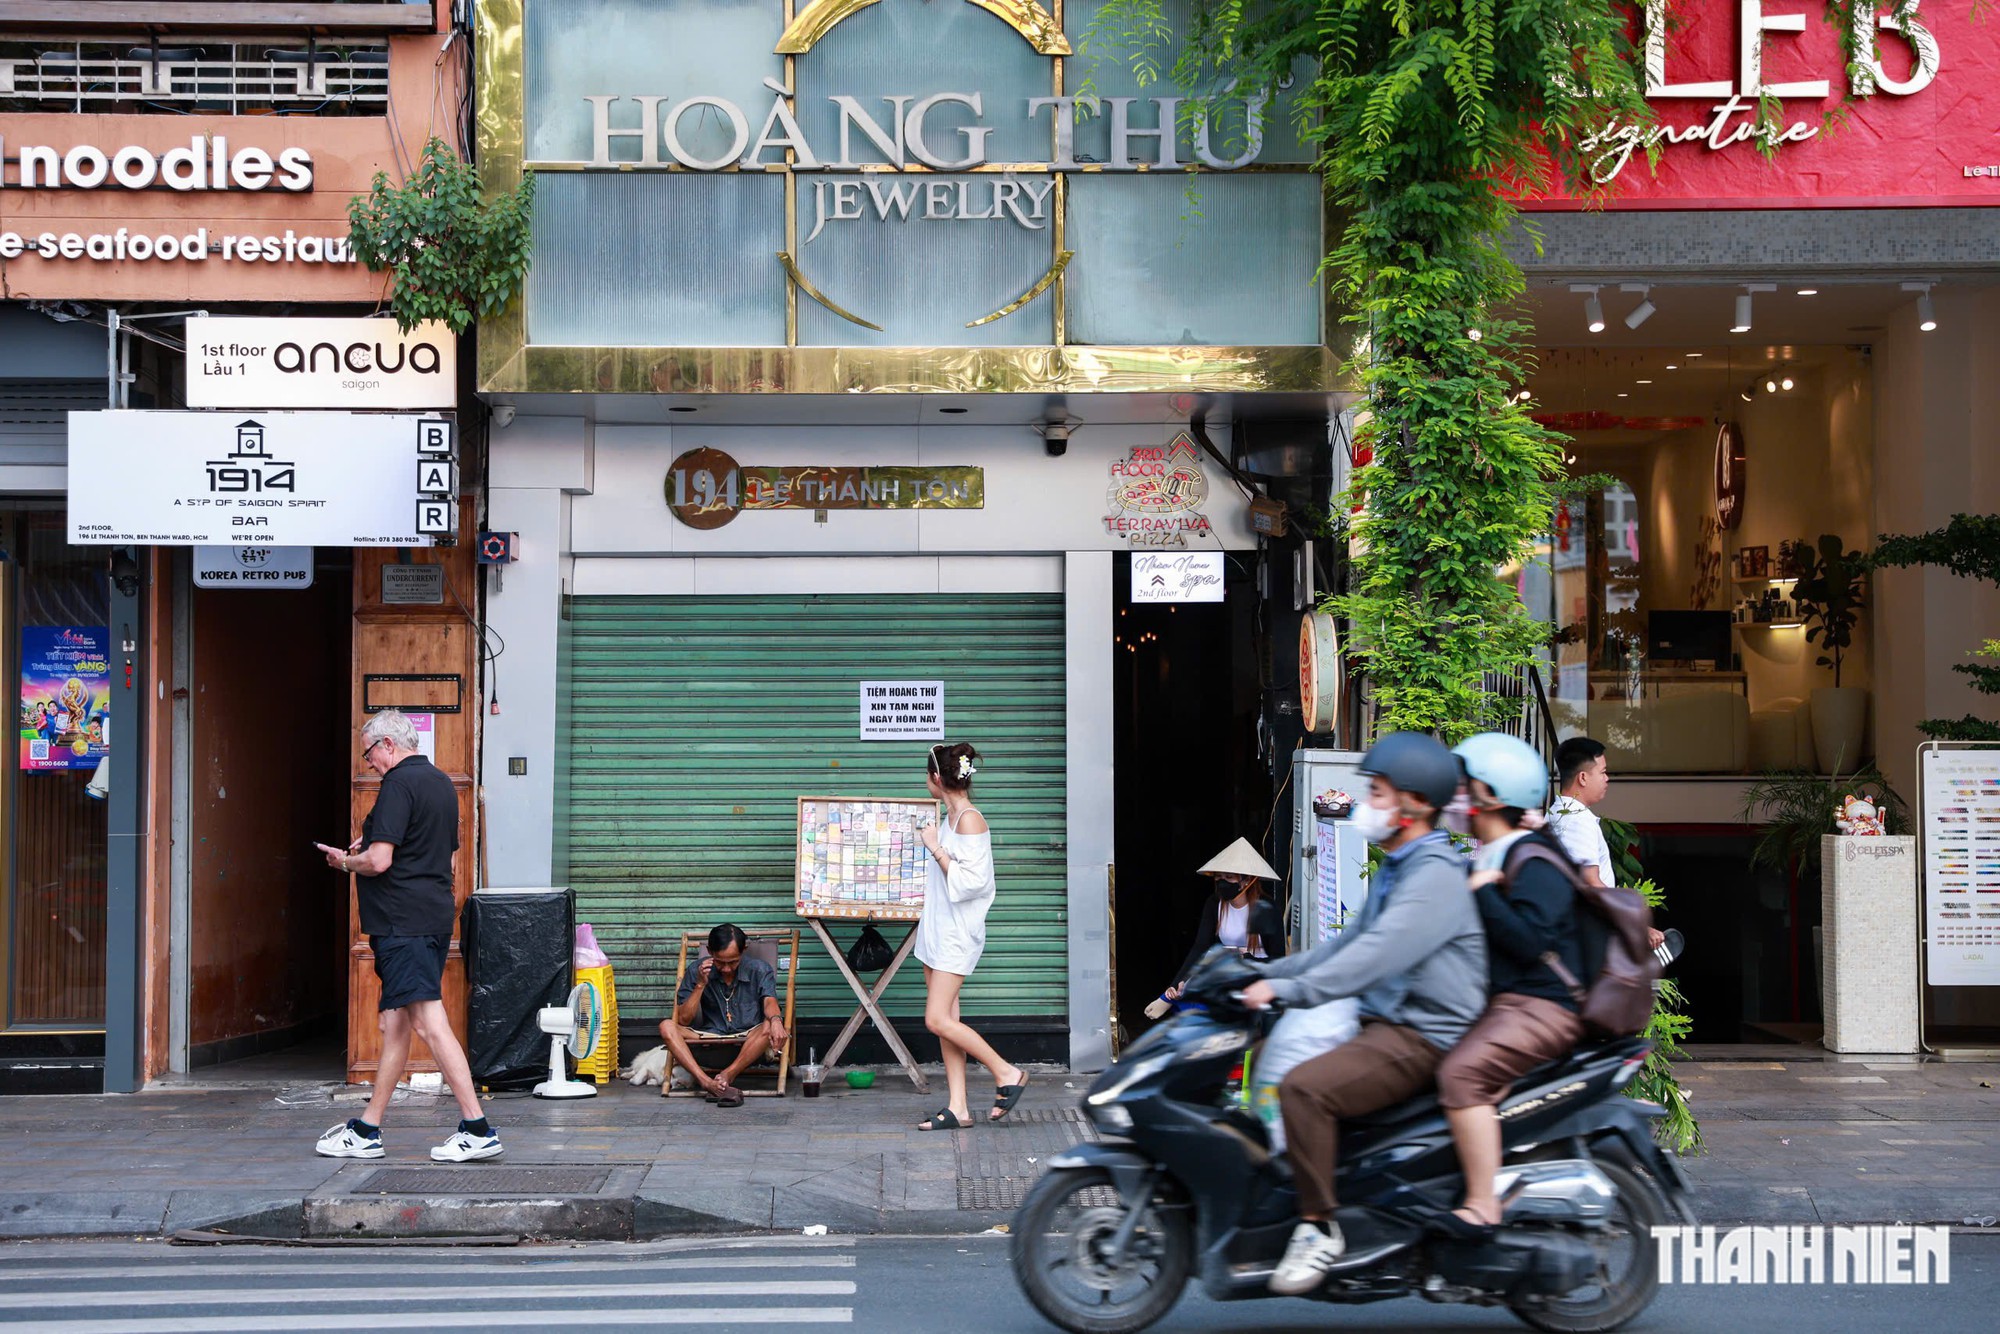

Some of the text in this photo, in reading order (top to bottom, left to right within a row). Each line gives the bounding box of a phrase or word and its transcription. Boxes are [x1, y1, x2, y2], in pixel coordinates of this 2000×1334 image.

[582, 76, 994, 171] HOÀNG
[1579, 95, 1819, 184] signature
[20, 135, 314, 191] noodles
[803, 180, 1057, 246] JEWELRY
[37, 227, 208, 261] seafood
[200, 341, 441, 375] 1st floor ancua
[203, 360, 246, 376] Lầu 1
[342, 379, 380, 391] saigon
[1132, 448, 1165, 461] 3RD
[1112, 463, 1165, 477] FLOOR
[206, 468, 295, 493] 1914
[674, 468, 969, 508] 194 LÊ THÁNH TÔN
[216, 499, 233, 507] OF
[238, 499, 283, 507] SAIGON
[288, 500, 327, 508] SPIRIT
[232, 516, 268, 526] BAR
[1105, 517, 1211, 531] TERRAVIVA
[172, 534, 192, 542] WARD,
[232, 534, 253, 542] WE'RE
[1130, 533, 1186, 546] PIZZA
[201, 571, 307, 580] KOREA RETRO PUB
[386, 574, 438, 582] UNDERCURRENT
[1180, 573, 1220, 598] spa
[1137, 588, 1178, 600] 2nd floor
[866, 685, 887, 698] TIỆM
[889, 685, 918, 697] HOÀNG
[871, 701, 935, 712] XIN TẠM NGHỈ
[869, 714, 937, 723] NGÀY HÔM NAY
